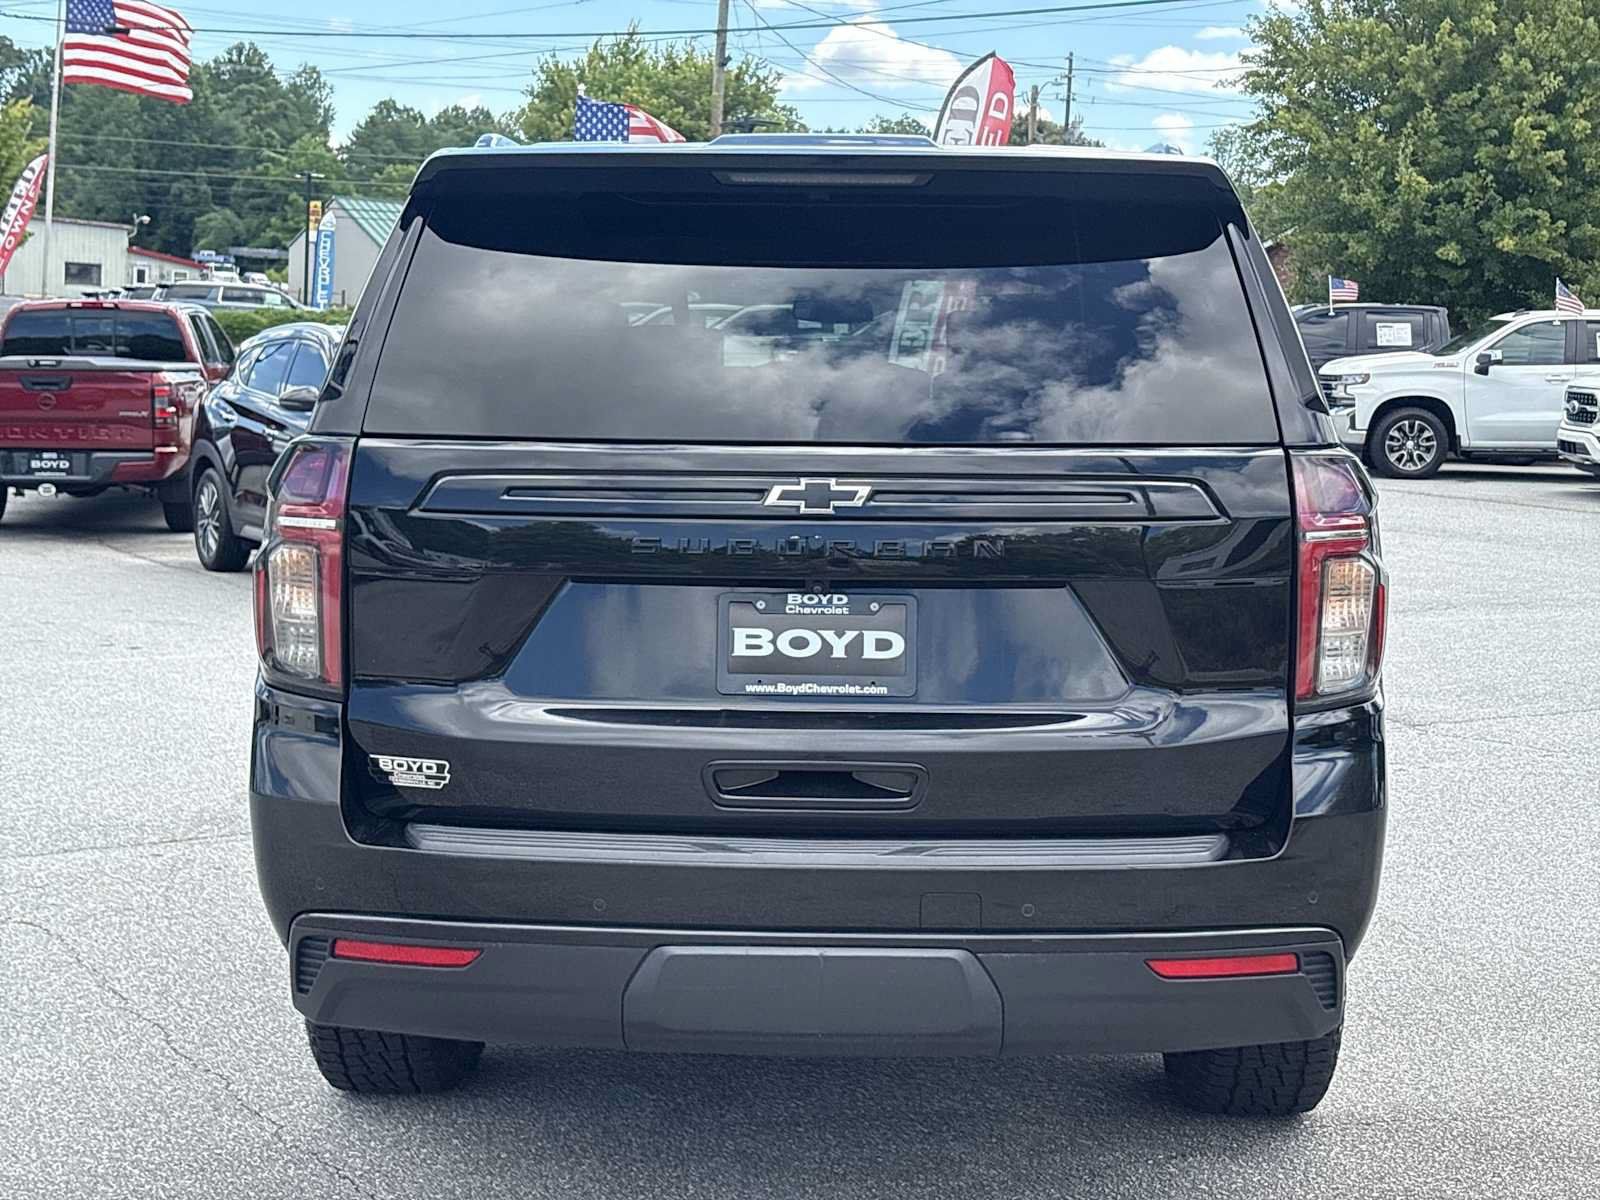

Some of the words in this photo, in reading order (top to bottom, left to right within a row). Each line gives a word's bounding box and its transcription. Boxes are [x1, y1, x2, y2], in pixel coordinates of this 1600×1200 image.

[31, 460, 70, 469] BOYD
[631, 535, 1006, 560] SUBURBAN
[787, 593, 849, 605] BOYD
[785, 605, 850, 615] Chevrolet
[731, 627, 906, 659] BOYD
[745, 683, 888, 695] www.BoydChevrolet.com
[379, 758, 438, 773] BOYD
